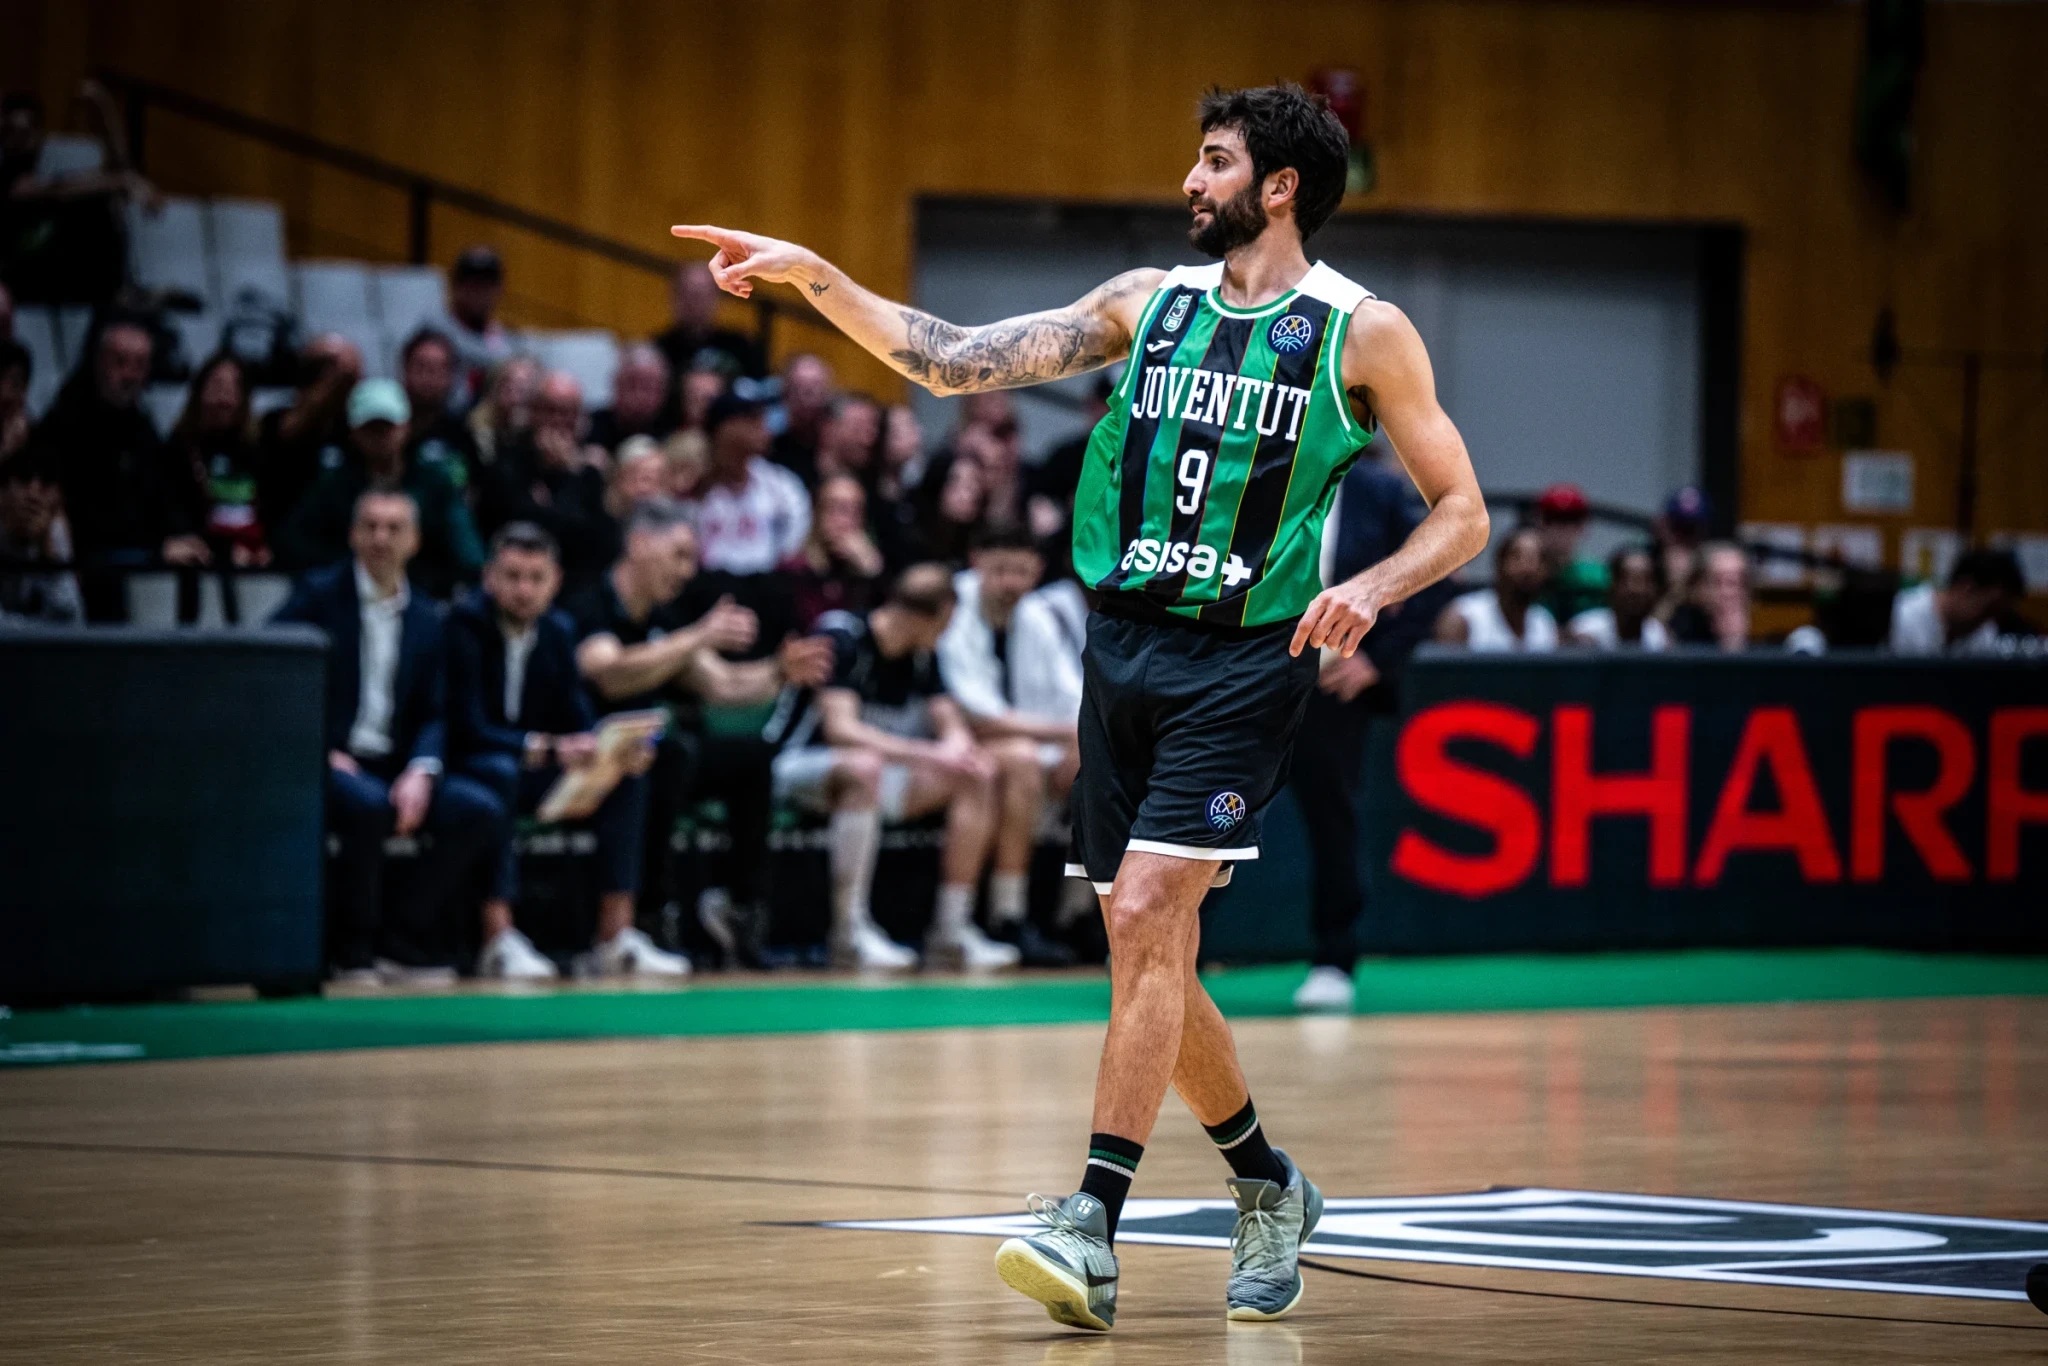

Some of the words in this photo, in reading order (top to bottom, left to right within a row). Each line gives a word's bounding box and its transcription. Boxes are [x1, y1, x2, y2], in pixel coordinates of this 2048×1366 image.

[1131, 366, 1311, 442] JOVENTUT
[1176, 449, 1209, 515] 9
[1121, 538, 1218, 579] asisa
